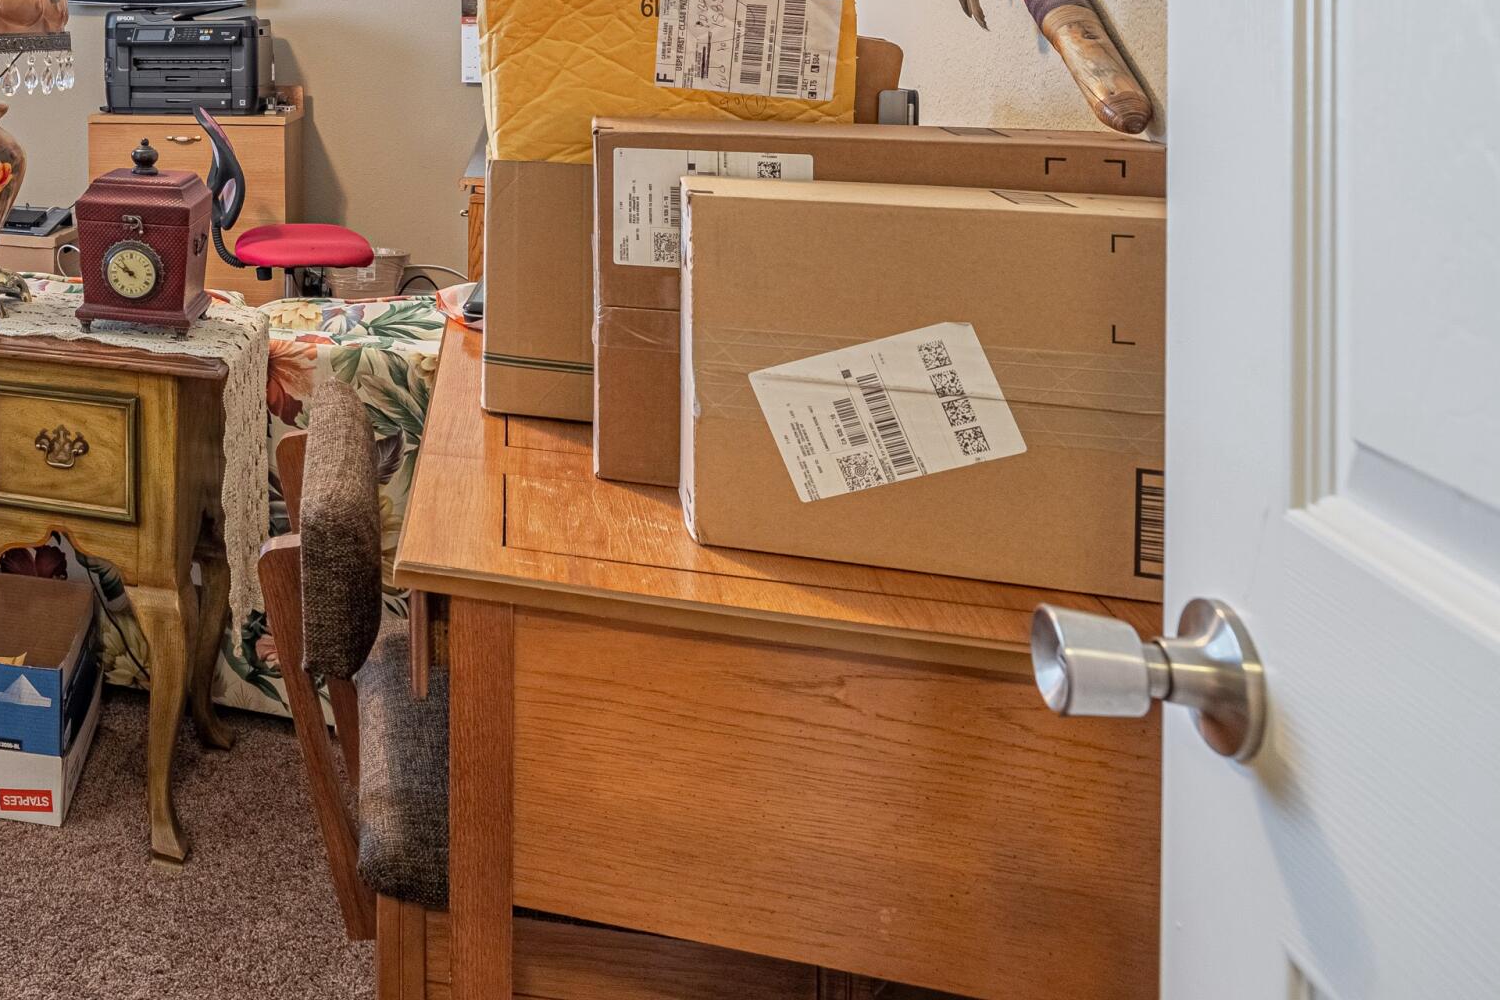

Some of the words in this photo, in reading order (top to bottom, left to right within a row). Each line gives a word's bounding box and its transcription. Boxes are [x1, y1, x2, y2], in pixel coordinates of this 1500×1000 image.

[676, 55, 684, 72] USPS
[656, 72, 674, 83] F
[3, 794, 50, 807] STAPLES
